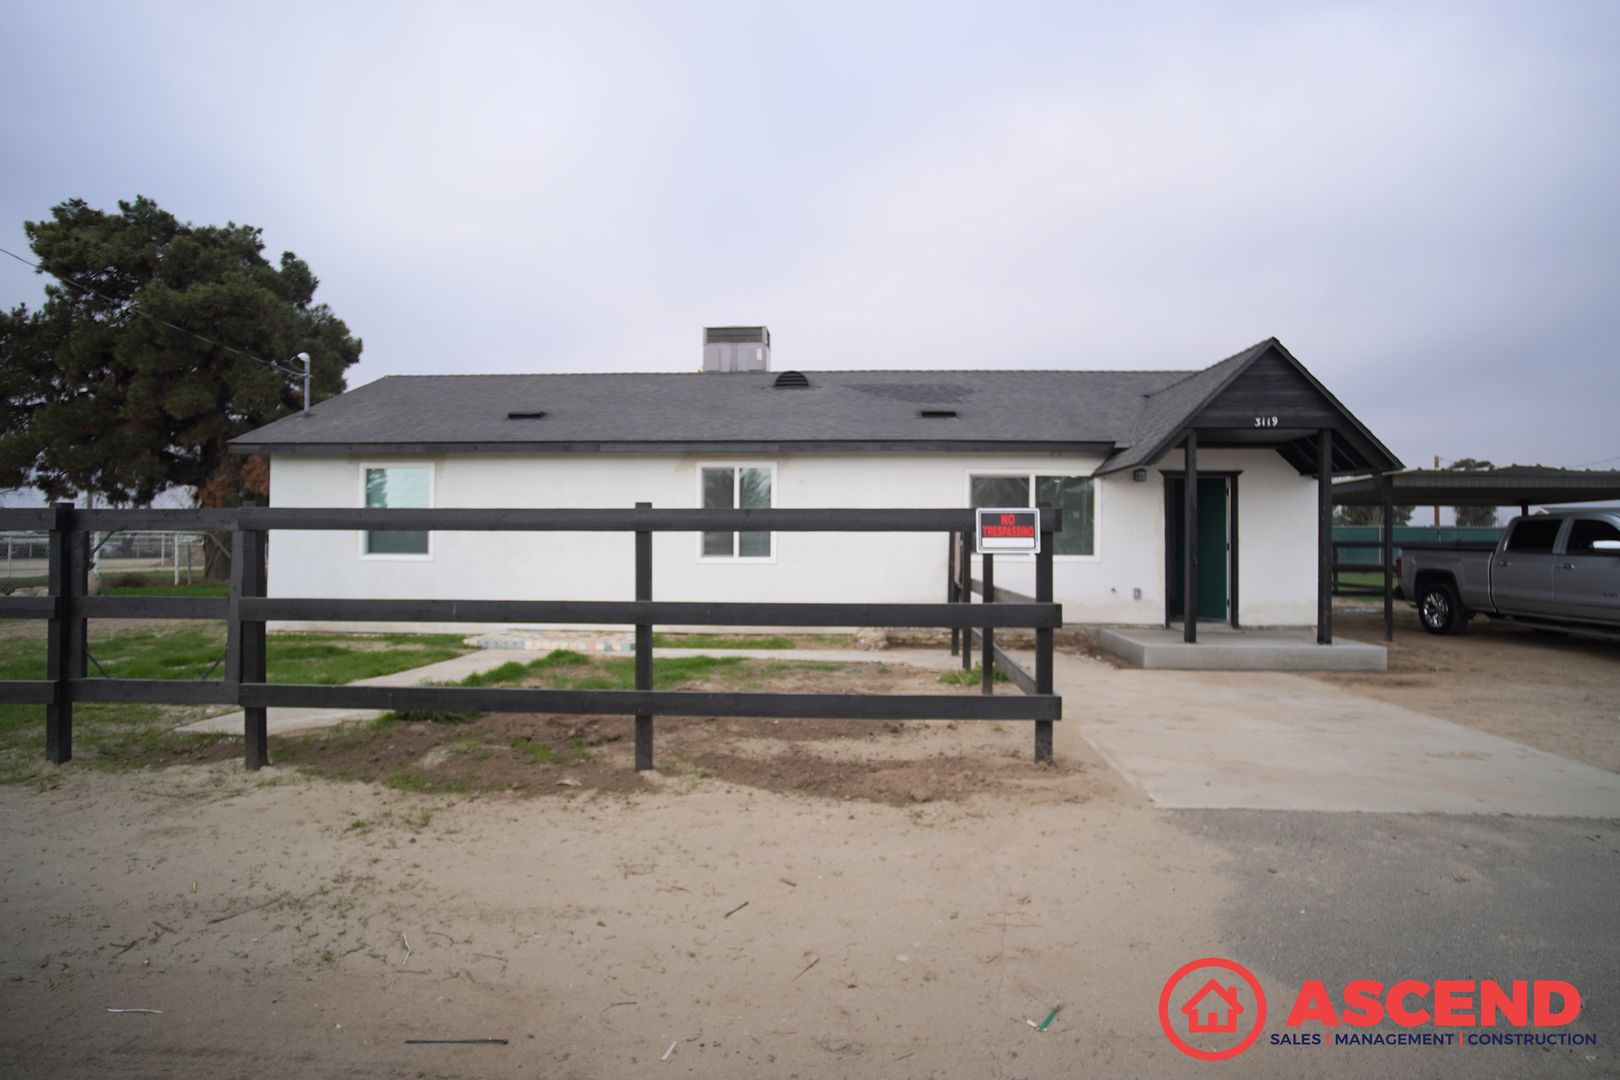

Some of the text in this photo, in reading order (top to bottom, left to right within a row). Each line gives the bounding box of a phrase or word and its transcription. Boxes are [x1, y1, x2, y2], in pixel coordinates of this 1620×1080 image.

[1254, 416, 1278, 427] 3119
[1000, 513, 1015, 525] NO
[982, 525, 1034, 537] TRESPASSING
